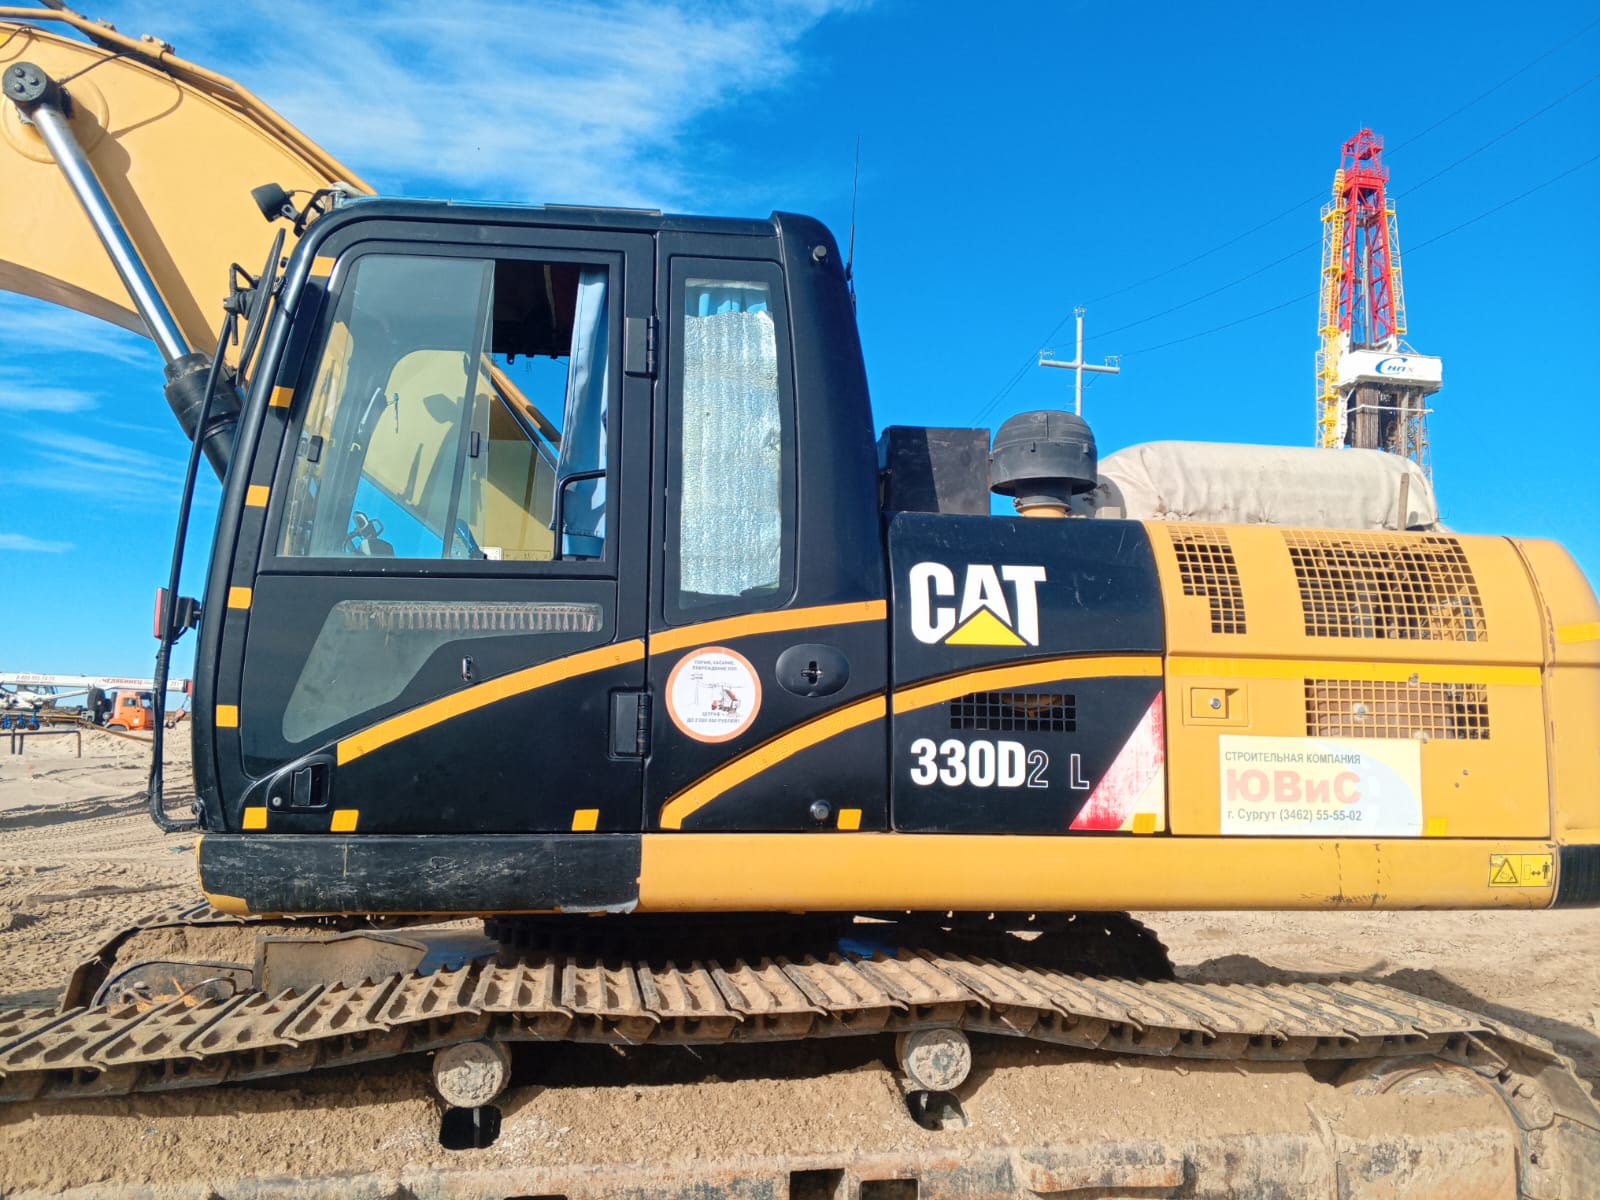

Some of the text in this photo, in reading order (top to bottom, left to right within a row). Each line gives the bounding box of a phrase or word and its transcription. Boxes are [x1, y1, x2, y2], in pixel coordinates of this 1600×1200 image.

[908, 561, 1047, 646] CAT
[910, 737, 1090, 790] 330D2 L
[1225, 751, 1361, 765] СТРОИТЕЛЬНАЯ КОМПАНИЯ
[1226, 768, 1361, 804] ЮВиС
[1227, 808, 1362, 823] г. Сургут (3462) 55-55-02
